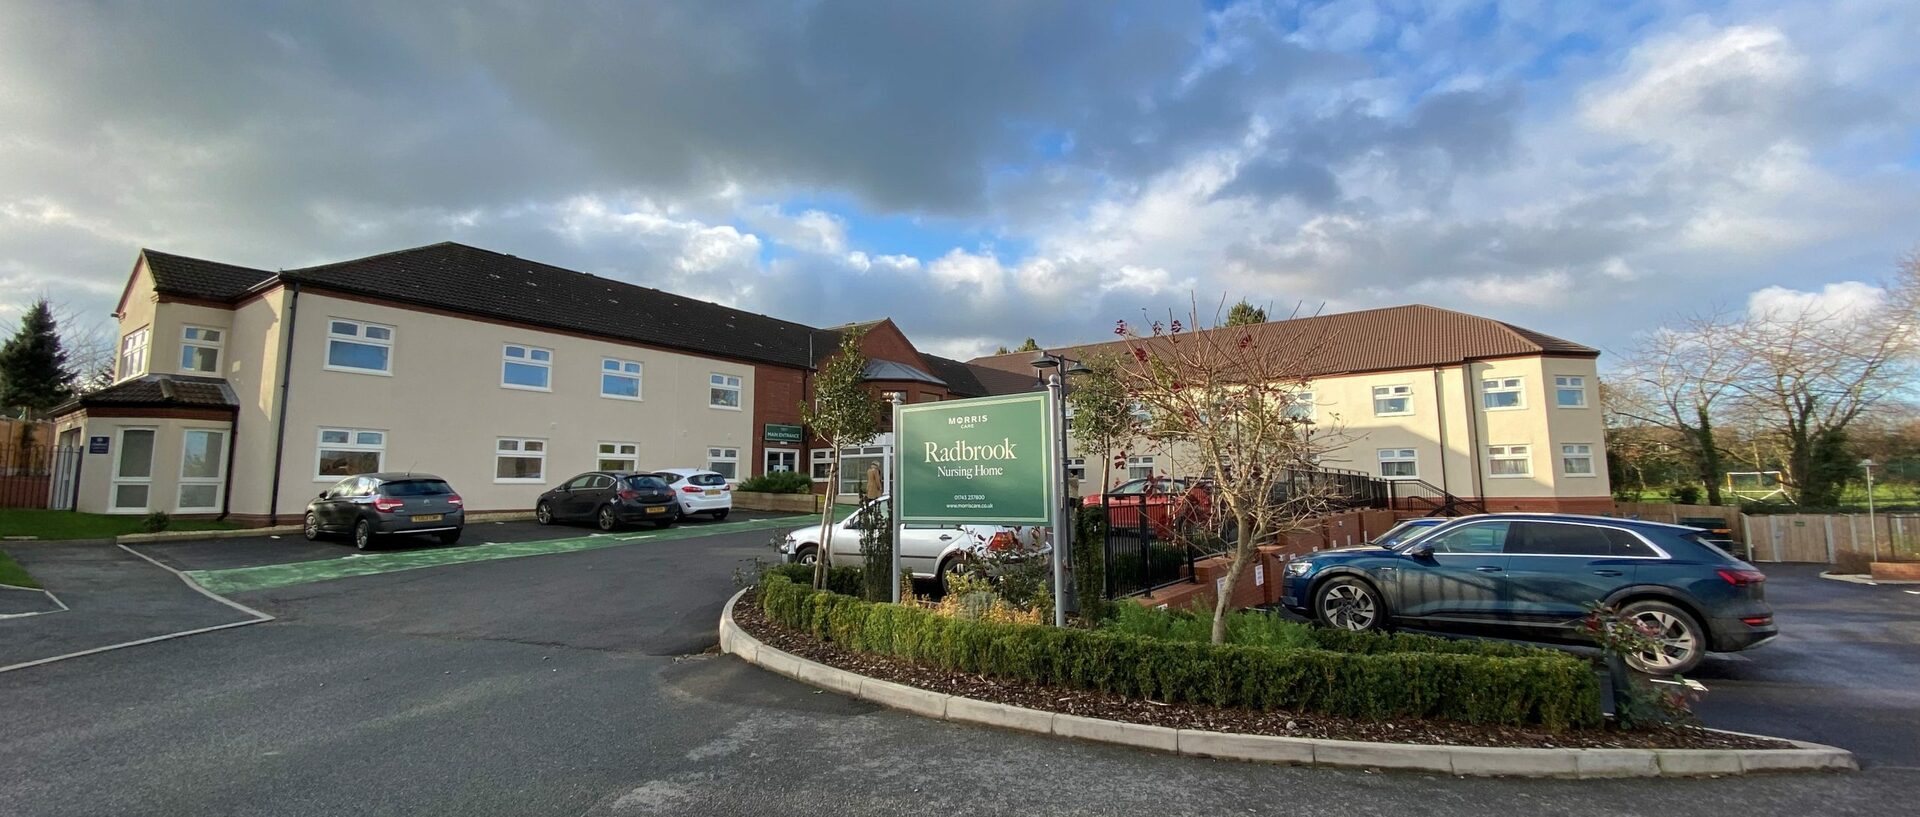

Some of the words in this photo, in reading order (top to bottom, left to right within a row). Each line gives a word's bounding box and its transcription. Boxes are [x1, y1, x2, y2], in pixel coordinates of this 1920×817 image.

[948, 414, 988, 424] MORRIS
[924, 437, 1017, 462] Radbrook
[937, 466, 972, 479] Nursing
[975, 465, 1003, 476] Home
